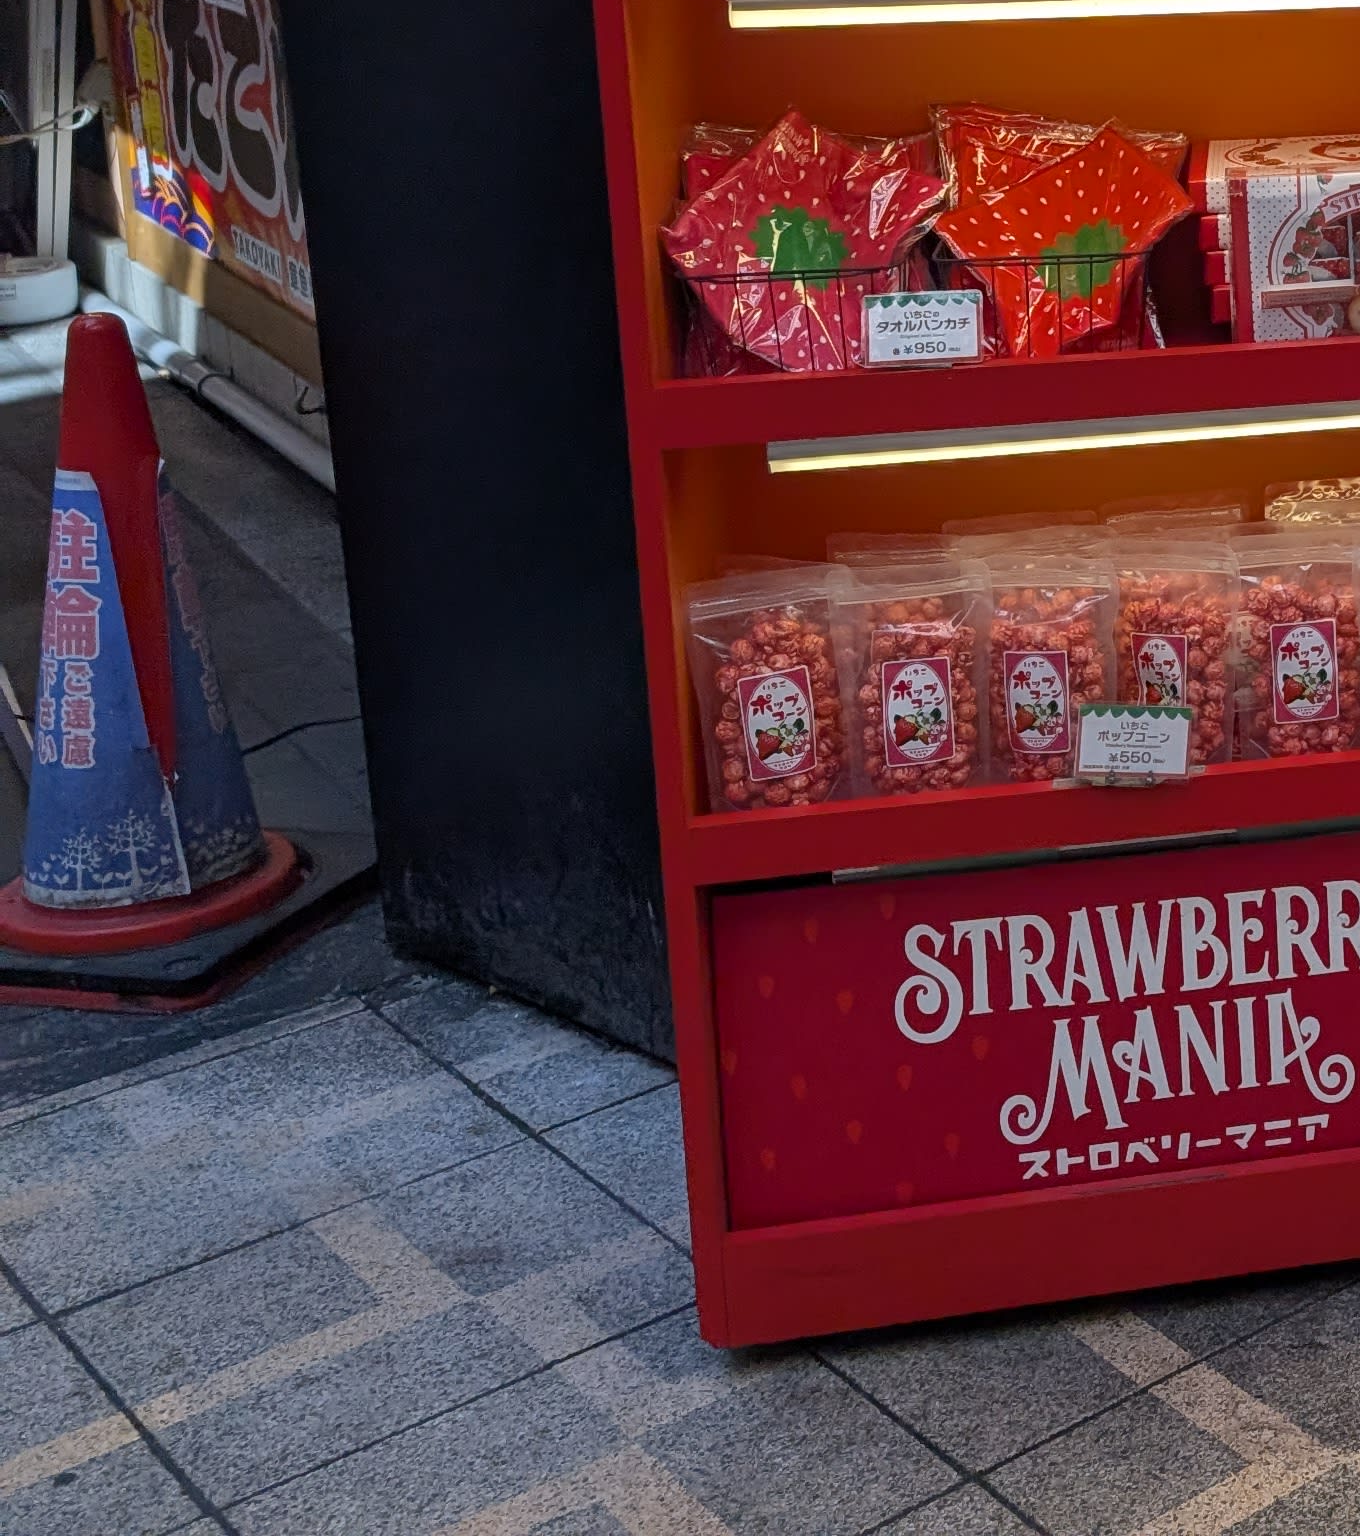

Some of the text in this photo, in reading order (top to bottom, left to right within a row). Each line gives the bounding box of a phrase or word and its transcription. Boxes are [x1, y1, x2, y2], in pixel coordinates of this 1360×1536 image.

[233, 229, 280, 280] TAKOYAKI
[876, 318, 970, 334] タオルハンカチ
[903, 341, 946, 354] ¥950
[1098, 731, 1170, 743] ポップコーン
[1109, 751, 1151, 764] ¥550
[1000, 988, 1355, 1145] MANIA
[1019, 1114, 1329, 1180] ストロベリーマニア
